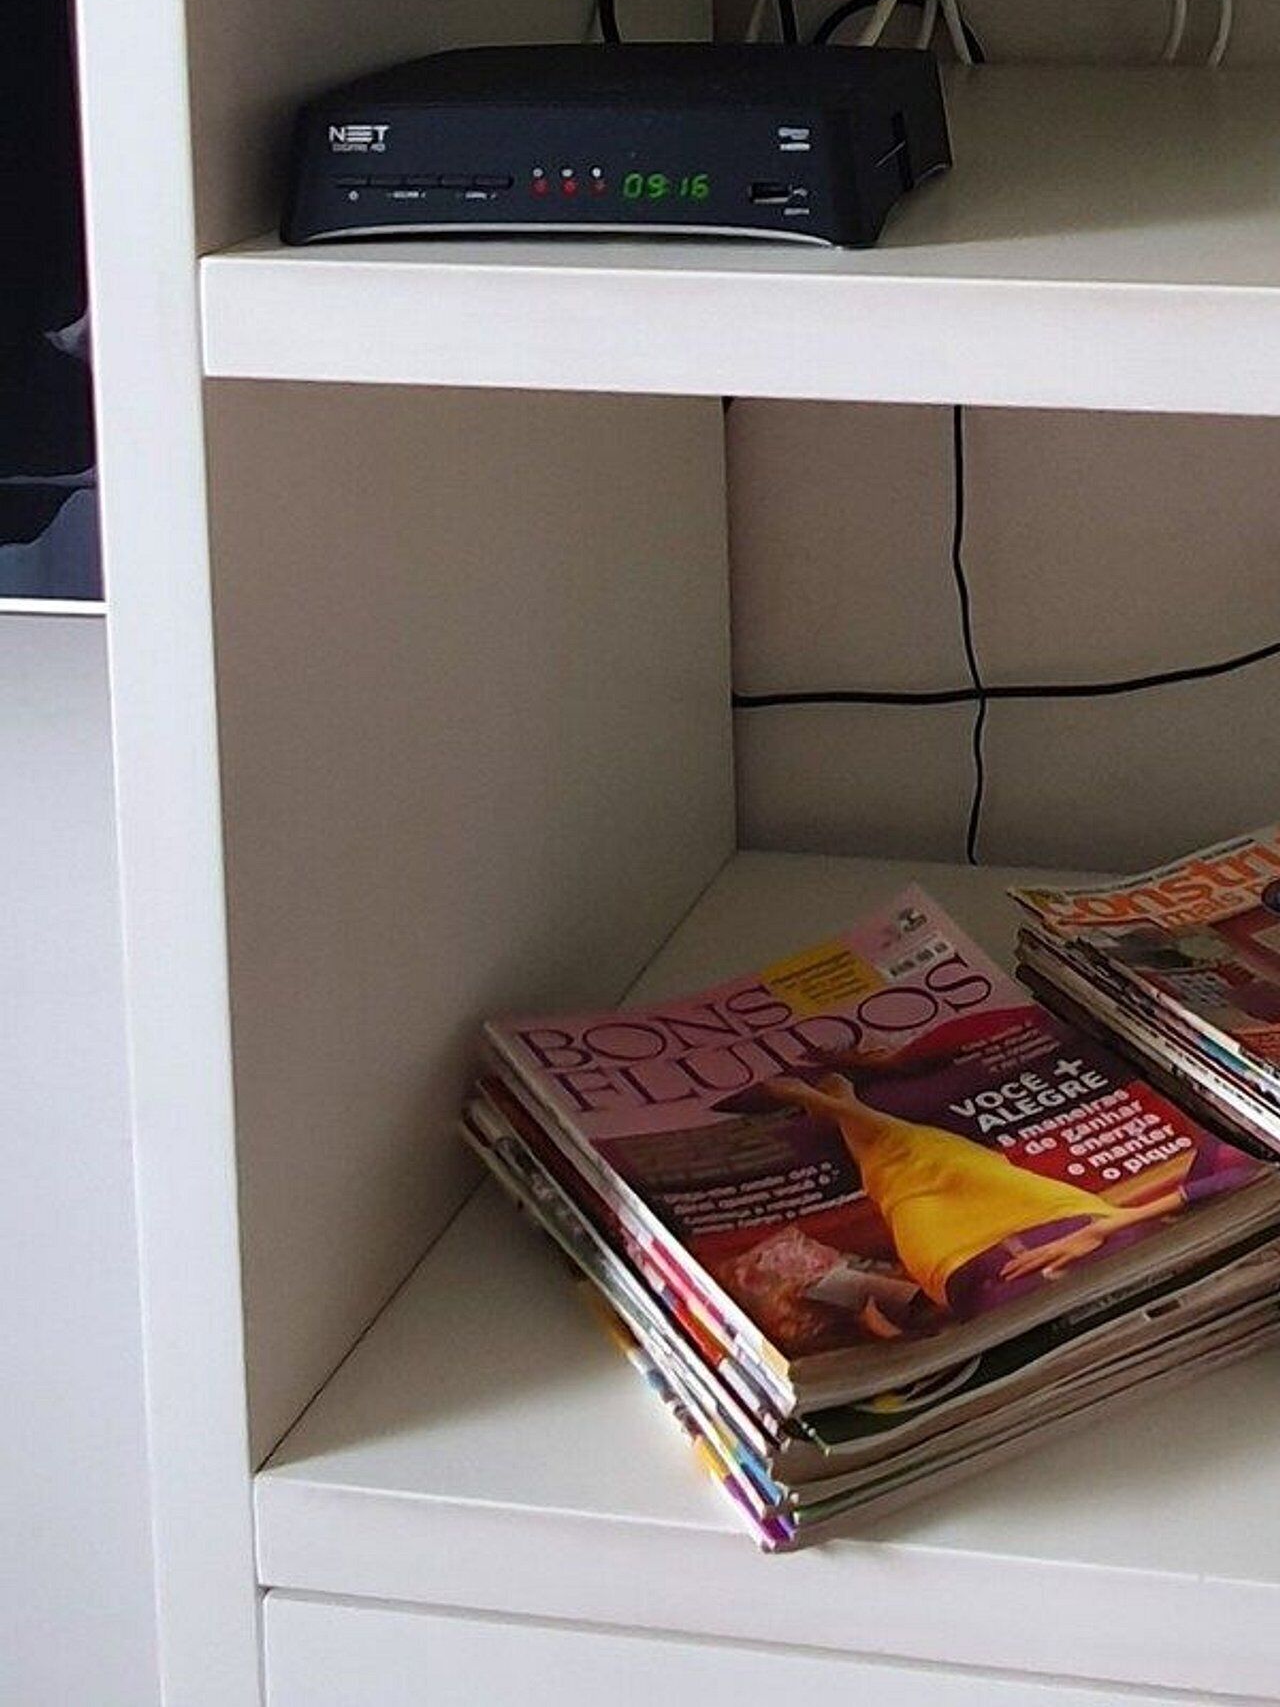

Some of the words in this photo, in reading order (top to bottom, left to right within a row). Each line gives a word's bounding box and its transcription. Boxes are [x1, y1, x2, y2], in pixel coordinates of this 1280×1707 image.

[328, 124, 390, 143] NET
[518, 985, 793, 1069] BONS
[557, 954, 992, 1112] FLUIDOS
[976, 1070, 1109, 1133] ALEGRE
[1017, 1088, 1130, 1140] maneiras
[1024, 1136, 1057, 1155] de
[1060, 1099, 1144, 1144] ganhar
[1069, 1113, 1161, 1157] energia
[1088, 1123, 1176, 1169] manter
[1122, 1137, 1192, 1174] pique
